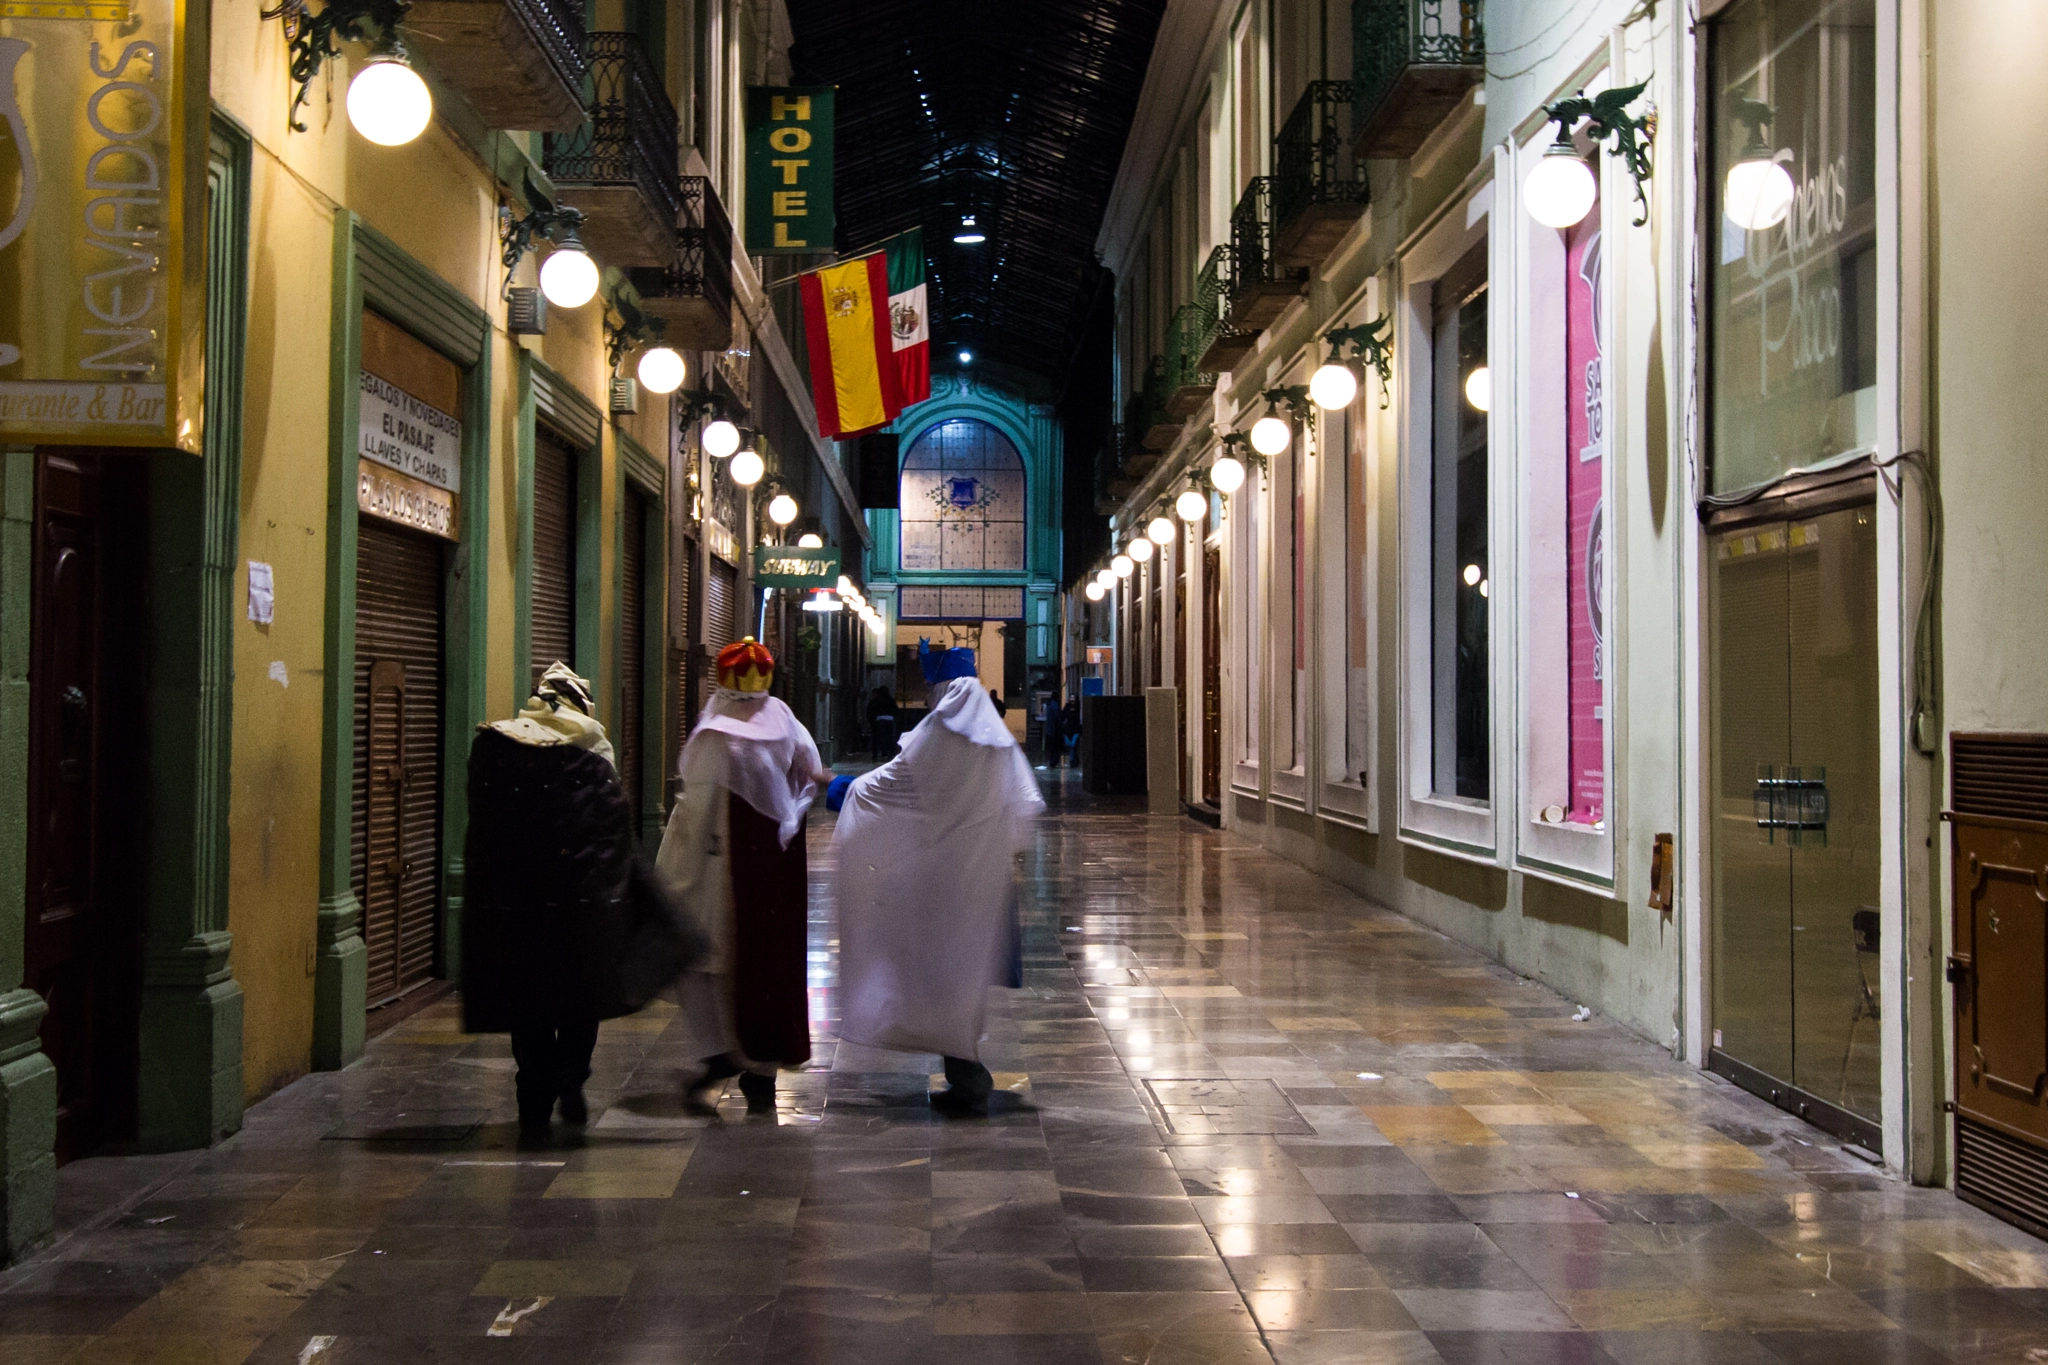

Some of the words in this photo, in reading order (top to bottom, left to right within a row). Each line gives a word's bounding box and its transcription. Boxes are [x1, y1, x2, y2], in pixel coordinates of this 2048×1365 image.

[769, 95, 812, 248] HOTEL
[80, 40, 161, 371] NEVADOS
[86, 385, 107, 421] &
[117, 386, 164, 422] Bar
[402, 393, 408, 411] Y
[409, 398, 459, 439] NOVEDADES
[383, 412, 395, 437] EL
[398, 420, 435, 455] PASAJE
[364, 433, 402, 465] LLAVES
[404, 452, 410, 469] Y
[412, 455, 447, 484] CHAPAS
[393, 484, 412, 523] LOS
[759, 558, 837, 577] SUBWAY
